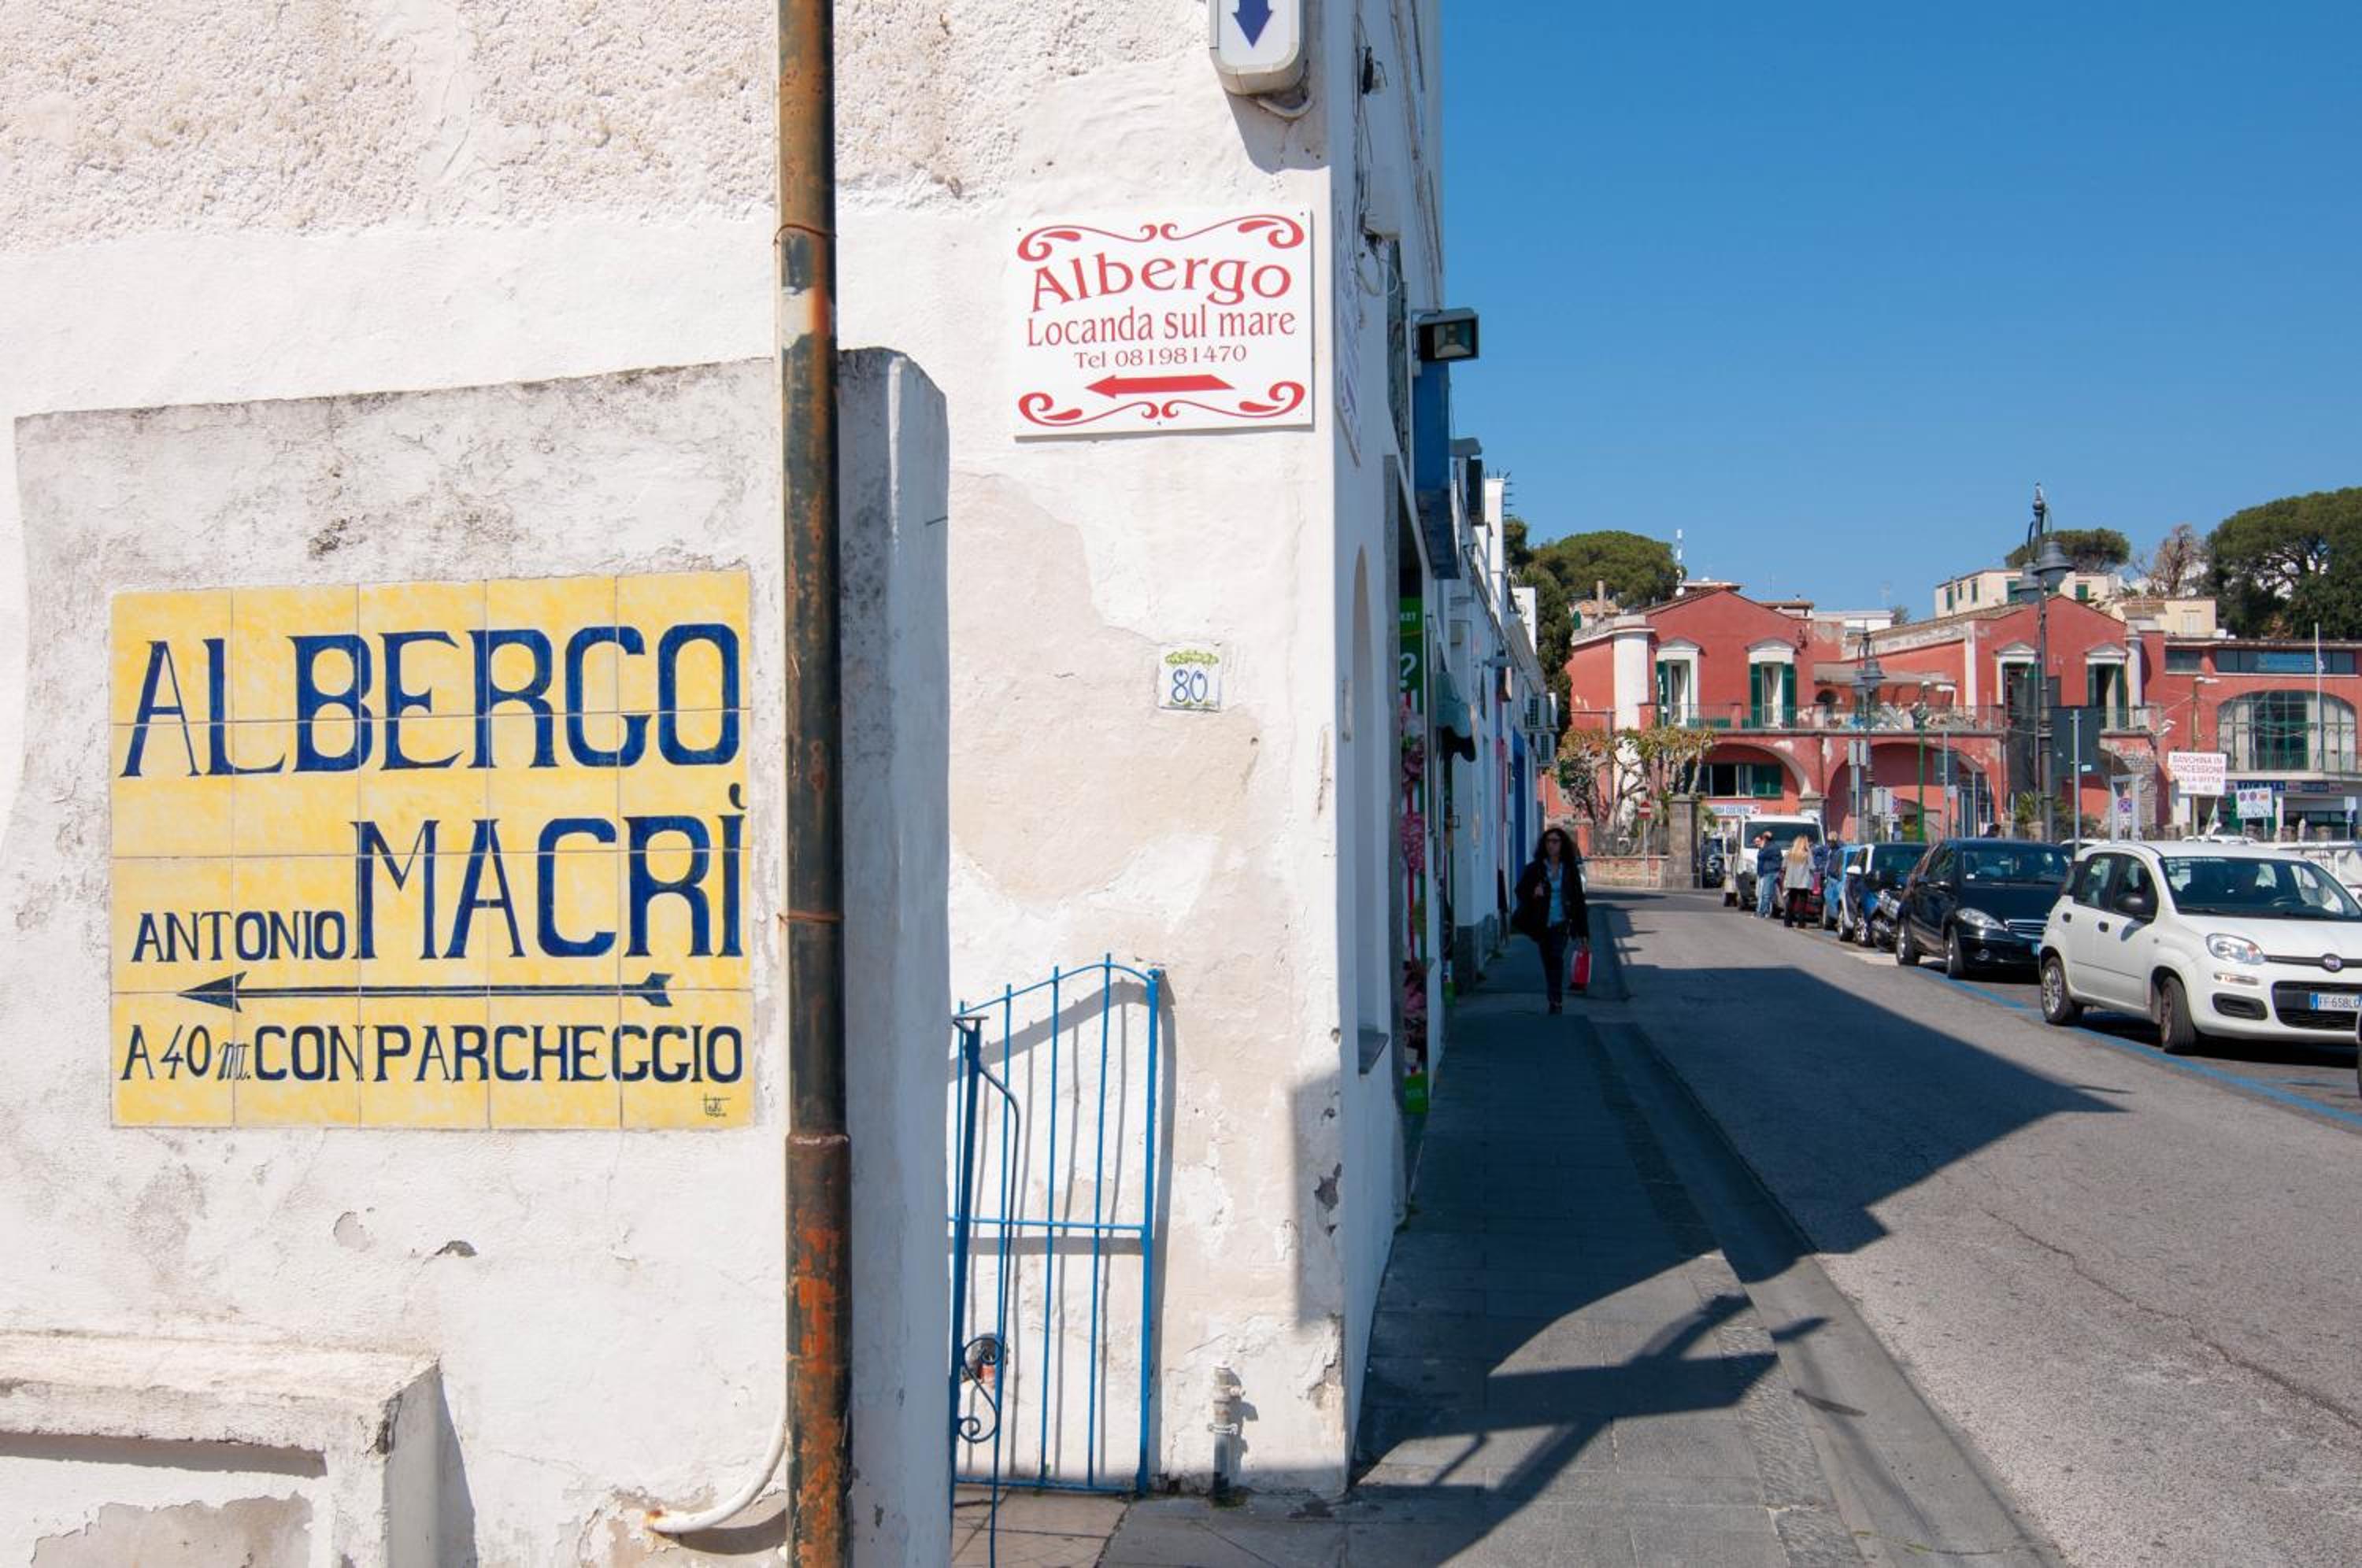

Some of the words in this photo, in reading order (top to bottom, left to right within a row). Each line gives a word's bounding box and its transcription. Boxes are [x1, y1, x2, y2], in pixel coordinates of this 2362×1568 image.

[1032, 251, 1292, 313] Albergo
[1027, 305, 1153, 348] Locanda
[1164, 304, 1208, 340] sul
[1218, 311, 1296, 338] mare
[1074, 349, 1107, 368] Tel
[1115, 345, 1248, 368] 081981470
[120, 623, 740, 778] ALBERGO
[1172, 668, 1208, 703] 80
[131, 910, 346, 963] ANTONIO
[351, 782, 746, 960] MACRÌ
[120, 1024, 154, 1082] A
[160, 1024, 212, 1079] 40
[254, 1024, 365, 1082] CON
[375, 1024, 743, 1084] PARCHEGGIO
